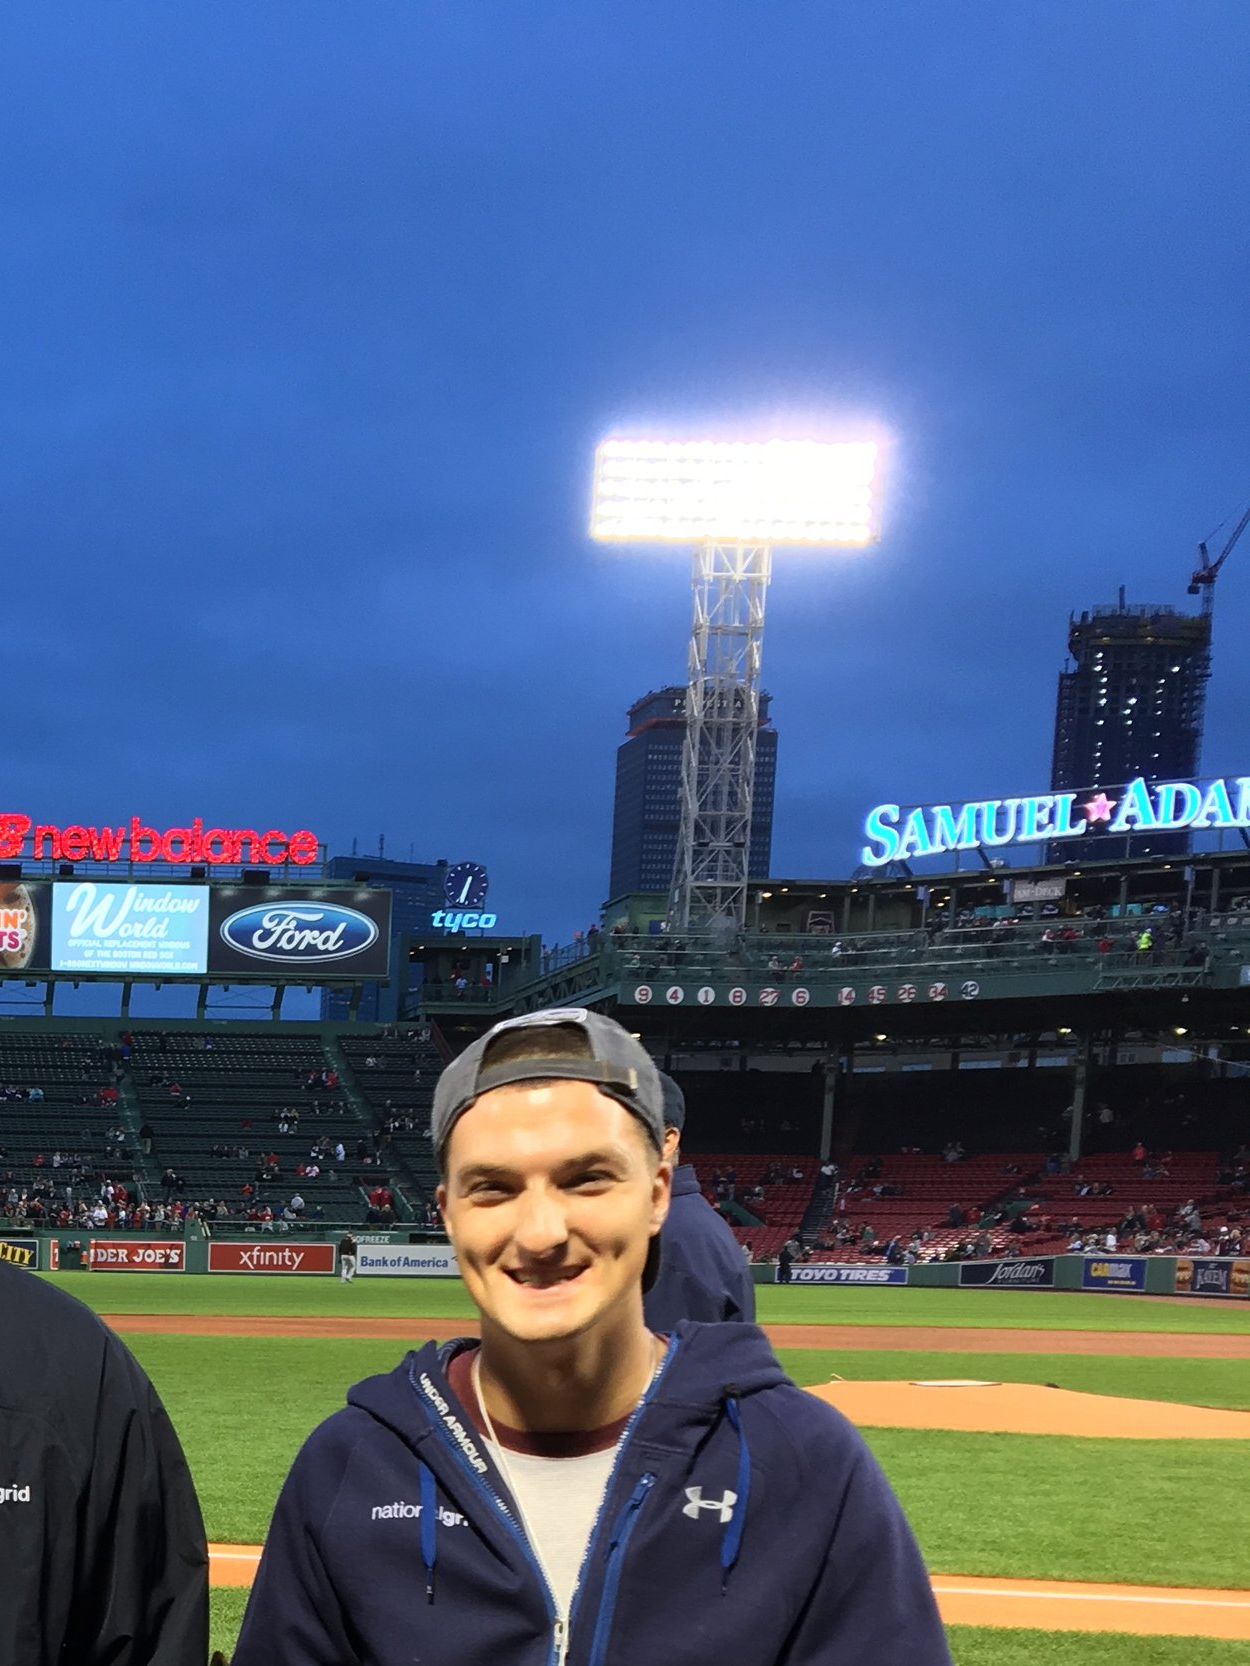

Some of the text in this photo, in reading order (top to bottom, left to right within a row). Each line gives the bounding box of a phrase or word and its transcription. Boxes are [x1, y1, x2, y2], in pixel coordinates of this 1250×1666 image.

[861, 793, 1088, 867] SAMUEL
[431, 908, 498, 932] tyco
[251, 909, 348, 951] Ford
[638, 987, 649, 1001] 9
[669, 989, 681, 1002] 4
[702, 990, 711, 1003] 1
[733, 990, 743, 1003] 8
[759, 989, 781, 1004] 27
[796, 990, 806, 1003] 6
[839, 990, 856, 1003] 14
[928, 985, 947, 999] 34
[961, 983, 978, 998] 42
[132, 1248, 183, 1264] JOE'S
[239, 1246, 305, 1270] xfinity
[360, 1256, 449, 1268] Bank of America
[790, 1268, 890, 1281] TOYO TIRES
[985, 1263, 1045, 1285] Jordan's
[419, 1372, 450, 1416] UNDER
[442, 1415, 488, 1474] ARMOUR
